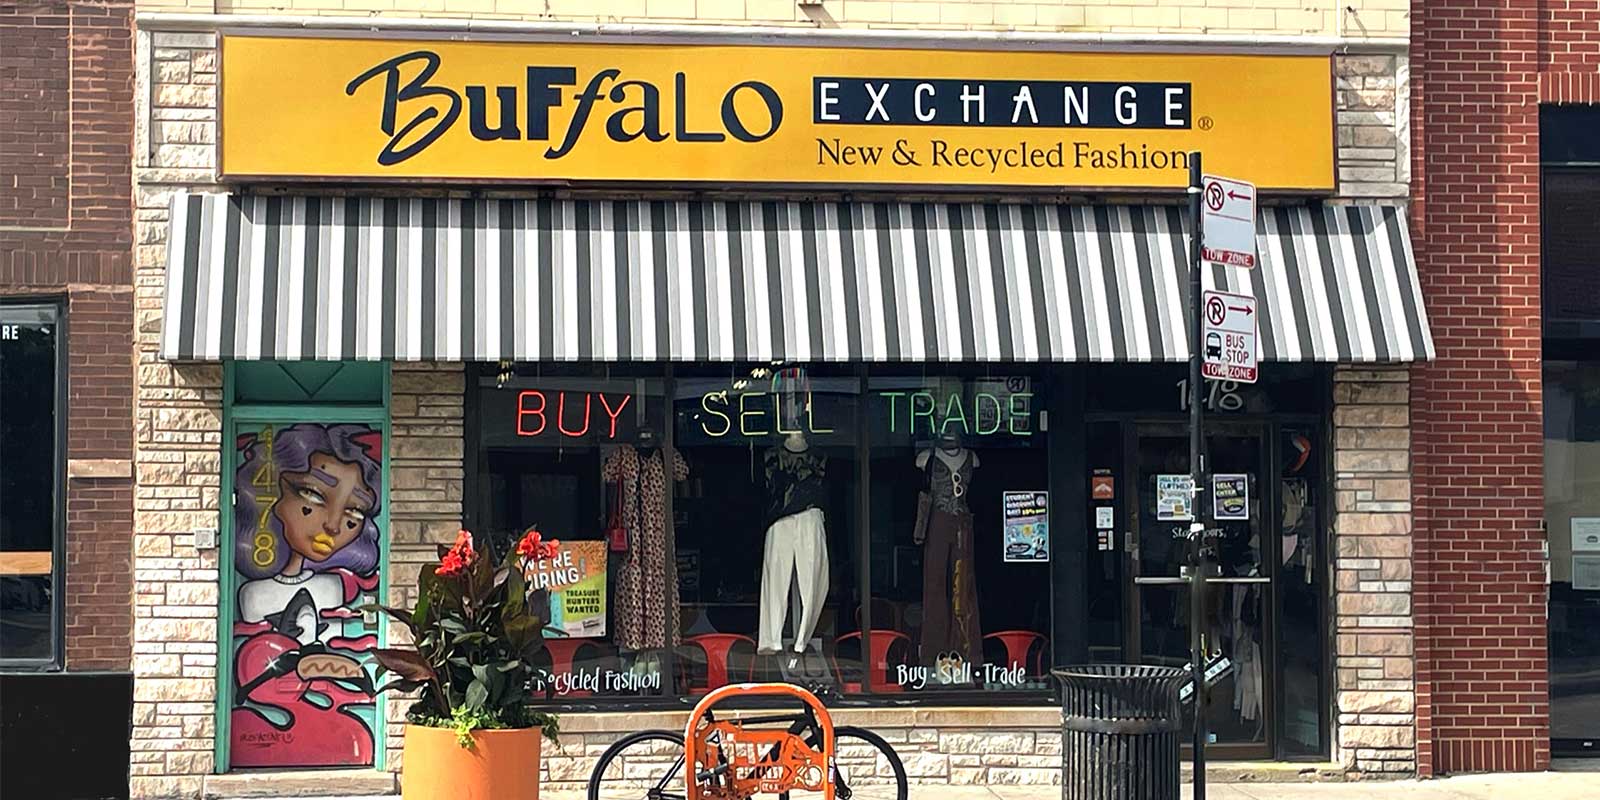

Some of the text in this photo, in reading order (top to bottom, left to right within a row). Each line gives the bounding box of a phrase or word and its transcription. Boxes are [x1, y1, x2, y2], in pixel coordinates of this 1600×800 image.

[819, 82, 1186, 126] EXCHANGE
[816, 138, 1189, 173] New & Recycled Fashion
[1205, 248, 1251, 266] TOW ZONE
[2, 325, 19, 340] RE
[1225, 334, 1245, 349] BUS
[1225, 350, 1249, 364] STOP
[1229, 366, 1253, 379] ZONE
[516, 391, 631, 438] BUY
[701, 391, 834, 436] SELL
[880, 391, 1035, 436] TRADE
[566, 589, 600, 597] TREASURE
[566, 597, 600, 605] HUNTERS
[566, 605, 600, 613] WANTED
[605, 667, 660, 691] Fashion
[896, 664, 928, 689] Buy
[940, 662, 972, 685] Sell
[982, 660, 1026, 687] Trade
